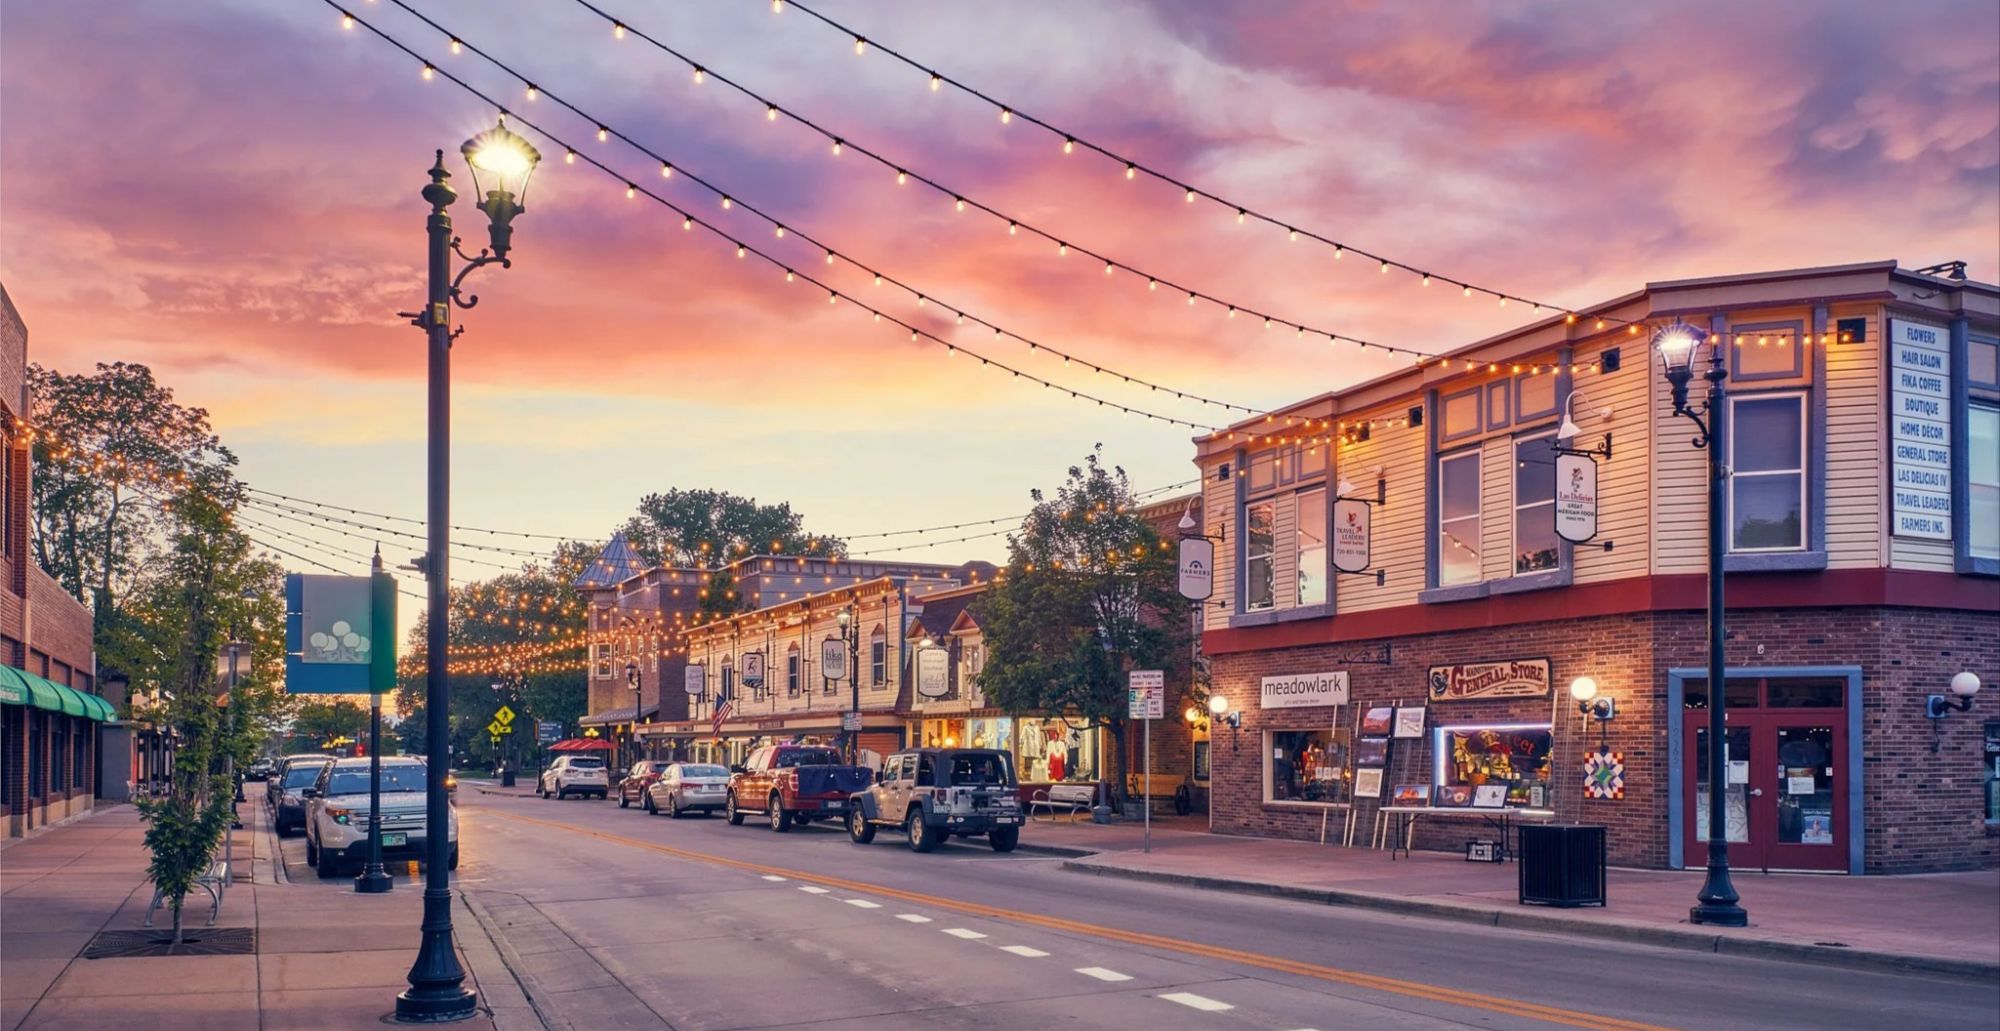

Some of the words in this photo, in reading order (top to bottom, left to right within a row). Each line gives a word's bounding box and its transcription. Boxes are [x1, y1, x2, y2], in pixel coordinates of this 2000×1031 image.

[1907, 327, 1936, 344] FLOWERS
[1901, 350, 1919, 366] HAIR
[1920, 353, 1942, 369] SALON
[1902, 374, 1918, 389] FIKA
[1919, 376, 1942, 392] COFFEE
[1905, 398, 1939, 416] BOUTIQUE
[1901, 422, 1920, 437] HOME
[1922, 423, 1944, 441] DÉCOR
[1897, 445, 1927, 461] GENERAL
[1928, 450, 1947, 464] STORE
[1898, 469, 1910, 483] LAS
[1911, 471, 1938, 486] DELICIAS
[1940, 474, 1947, 487] IV
[1896, 493, 1921, 508] TRAVEL
[1922, 495, 1949, 511] LEADERS
[1901, 517, 1931, 532] FARMERS
[1932, 519, 1945, 534] INS.
[1181, 568, 1210, 577] FARMERS
[1265, 674, 1342, 696] meadowlark
[1451, 664, 1508, 696] GENERAL
[1510, 661, 1544, 682] STORE
